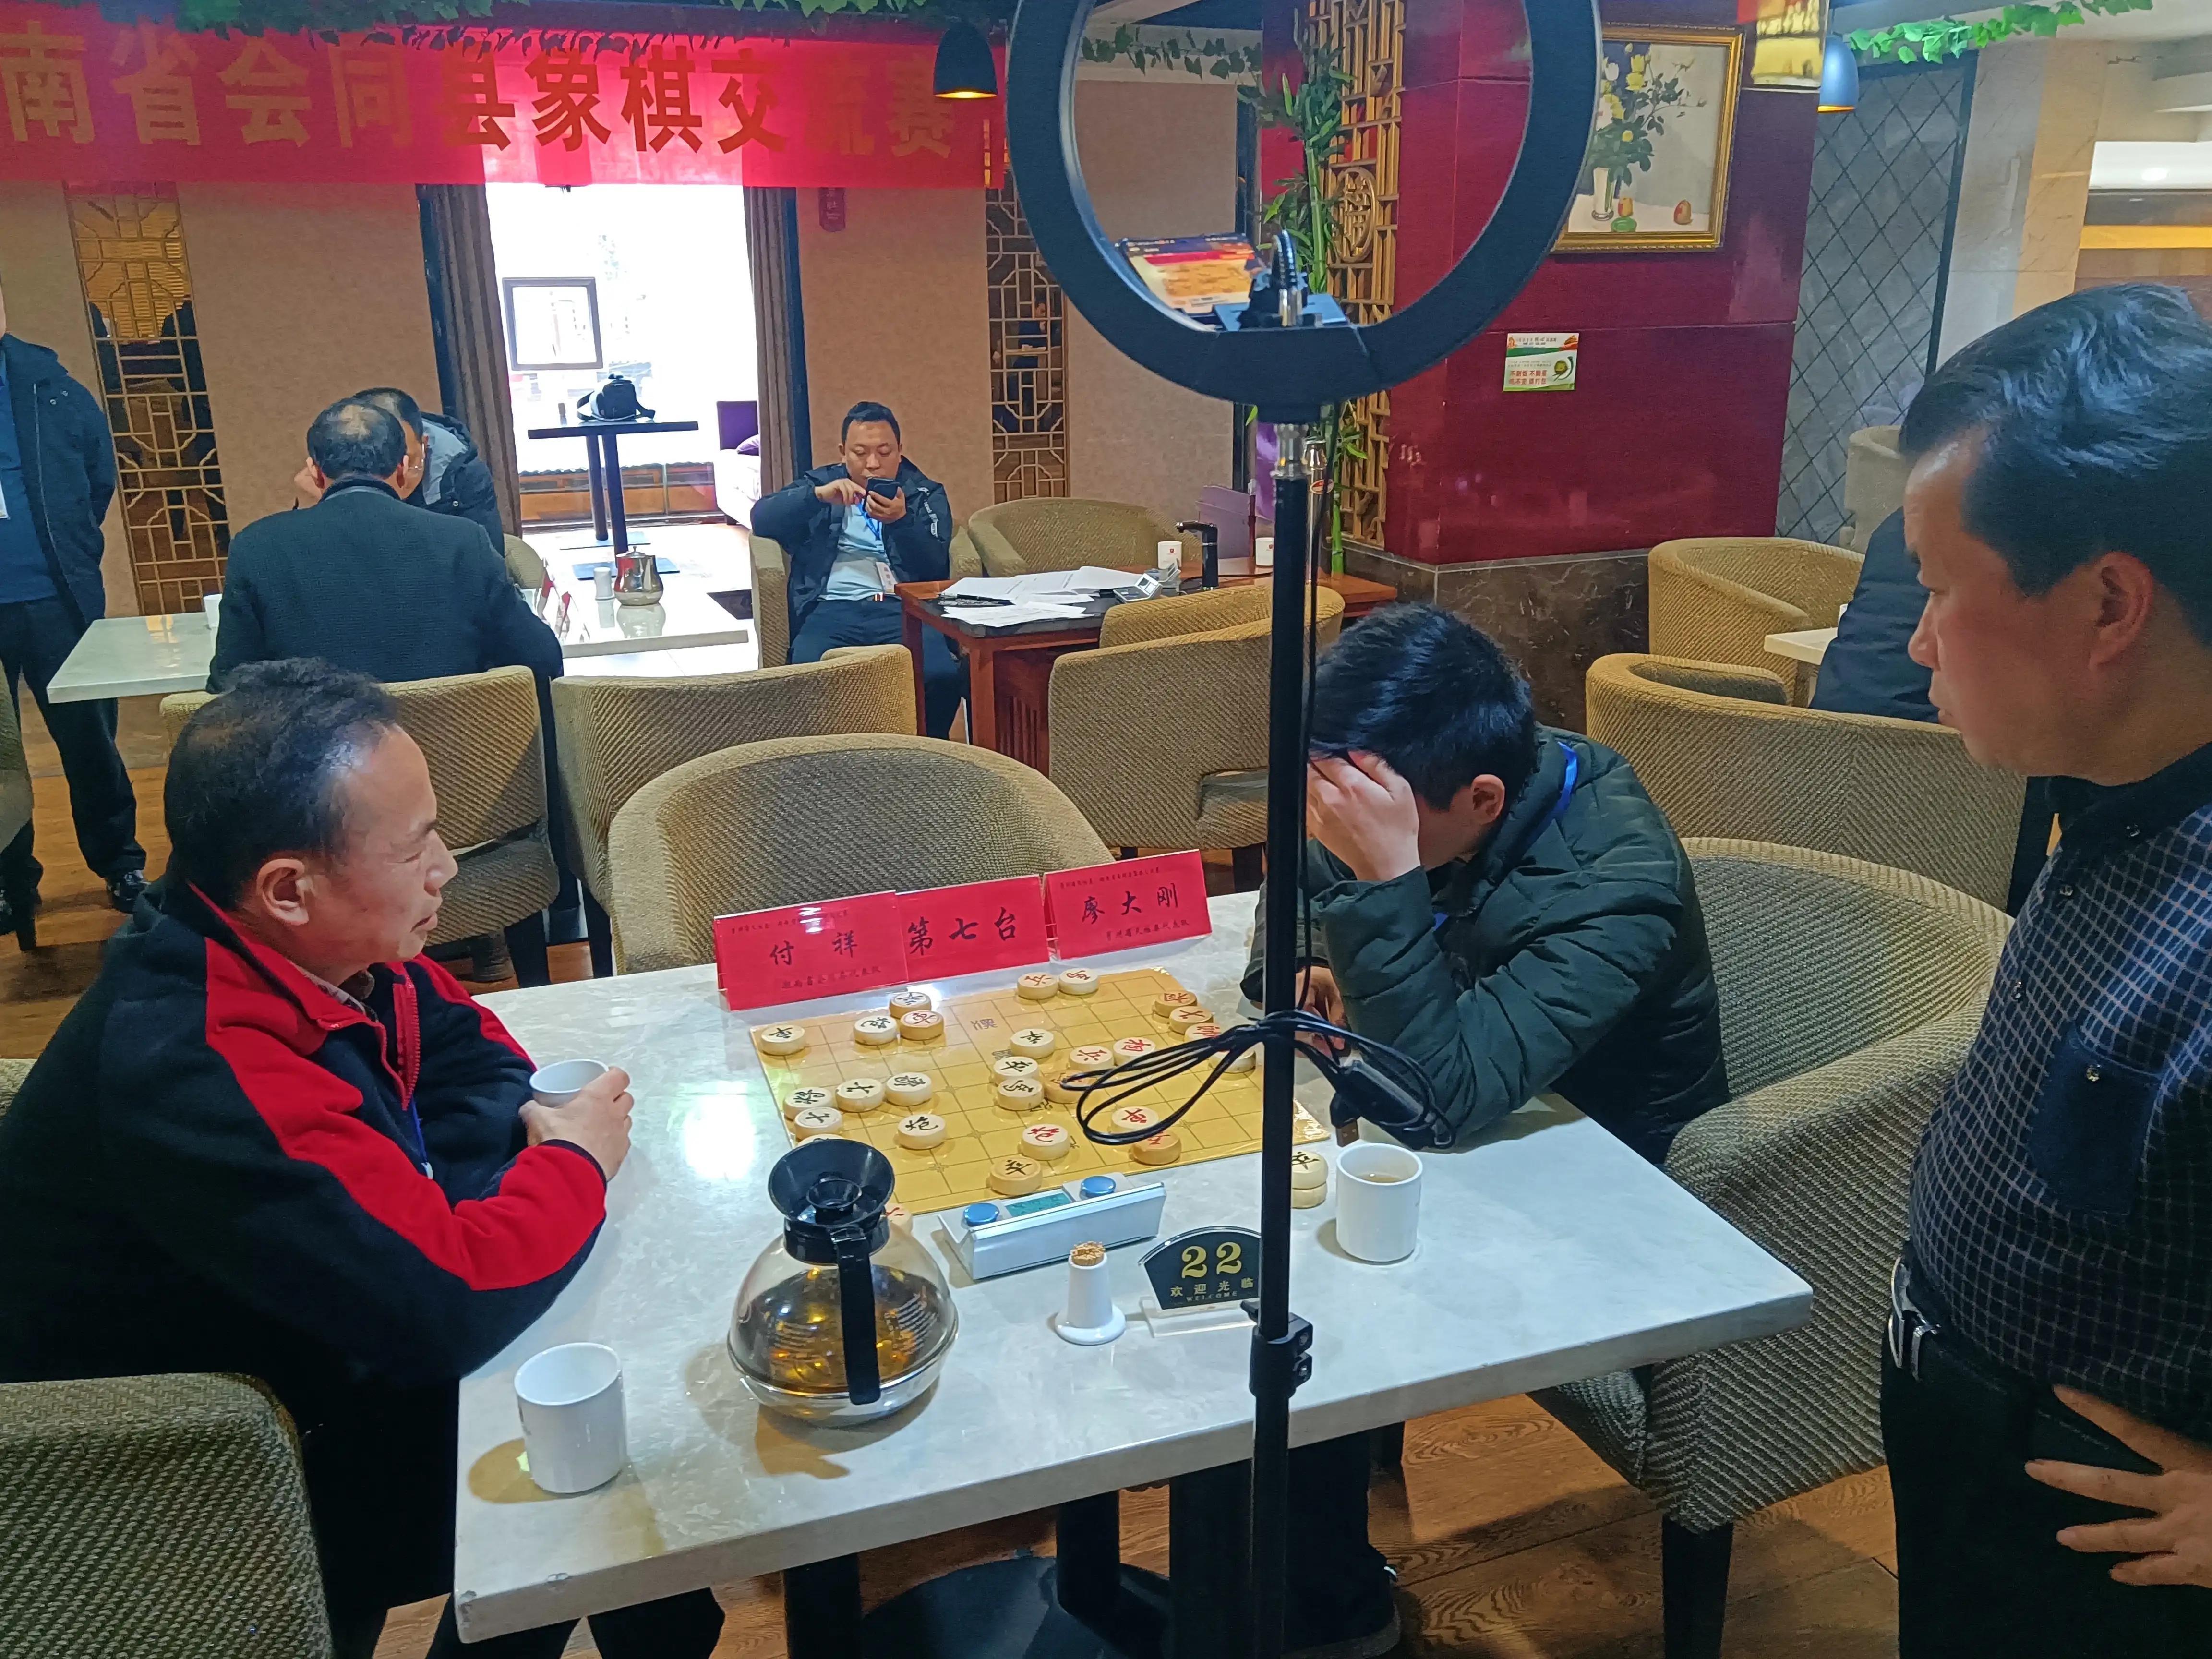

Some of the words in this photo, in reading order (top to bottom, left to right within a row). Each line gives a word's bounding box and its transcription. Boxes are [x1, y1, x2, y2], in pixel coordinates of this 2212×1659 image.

[1082, 882, 1178, 925] 廖大刚
[908, 906, 1016, 955] 第七台
[1181, 1242, 1242, 1278] 22
[1170, 1277, 1254, 1297] 欢迎光临
